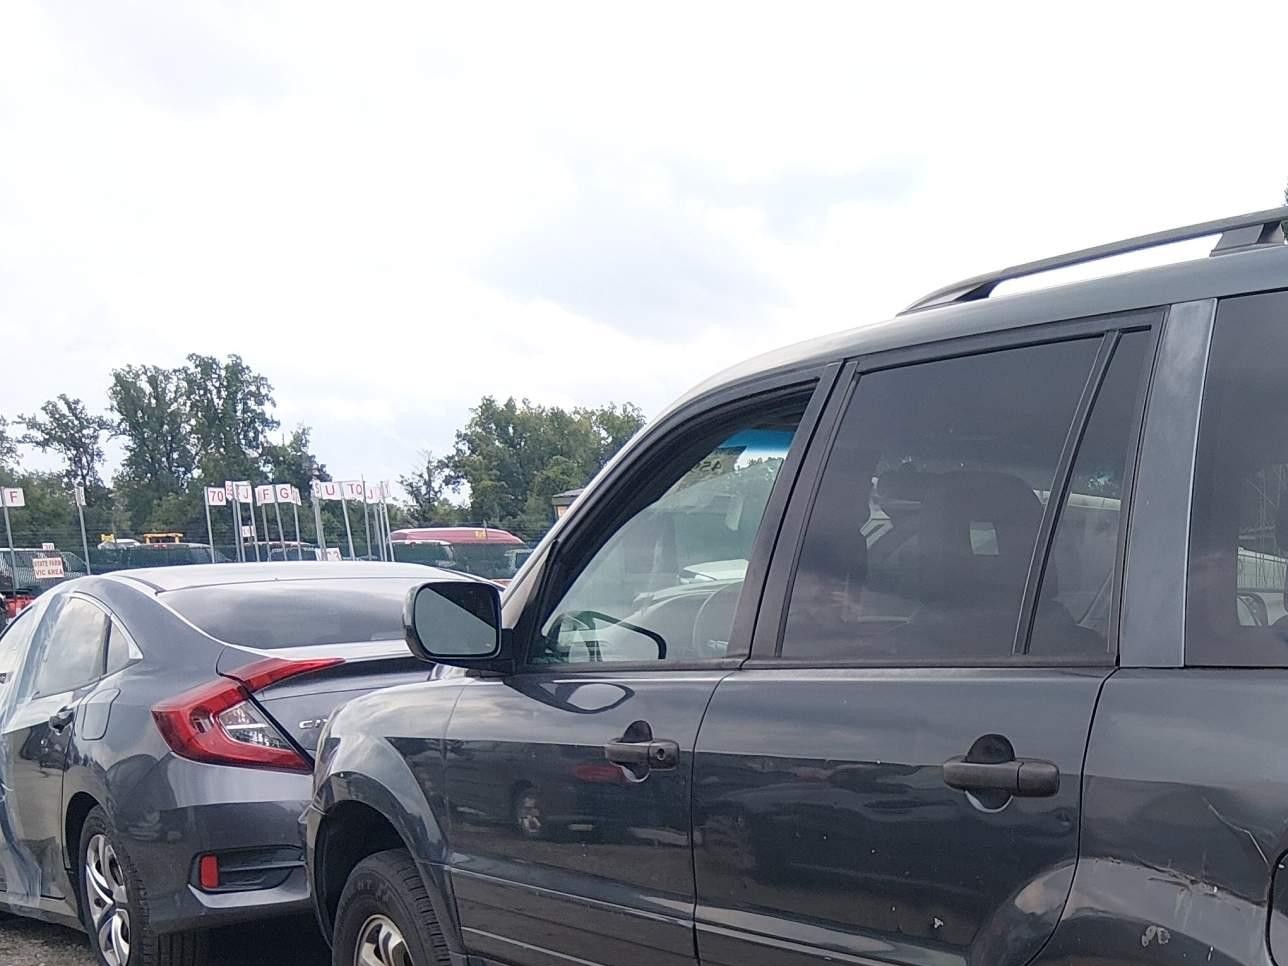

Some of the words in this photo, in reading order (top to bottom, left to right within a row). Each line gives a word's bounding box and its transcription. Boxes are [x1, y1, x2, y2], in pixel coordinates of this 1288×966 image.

[9, 490, 18, 503] F
[209, 490, 224, 502] 70
[262, 488, 270, 500] F
[279, 487, 290, 499] G
[325, 485, 336, 496] U
